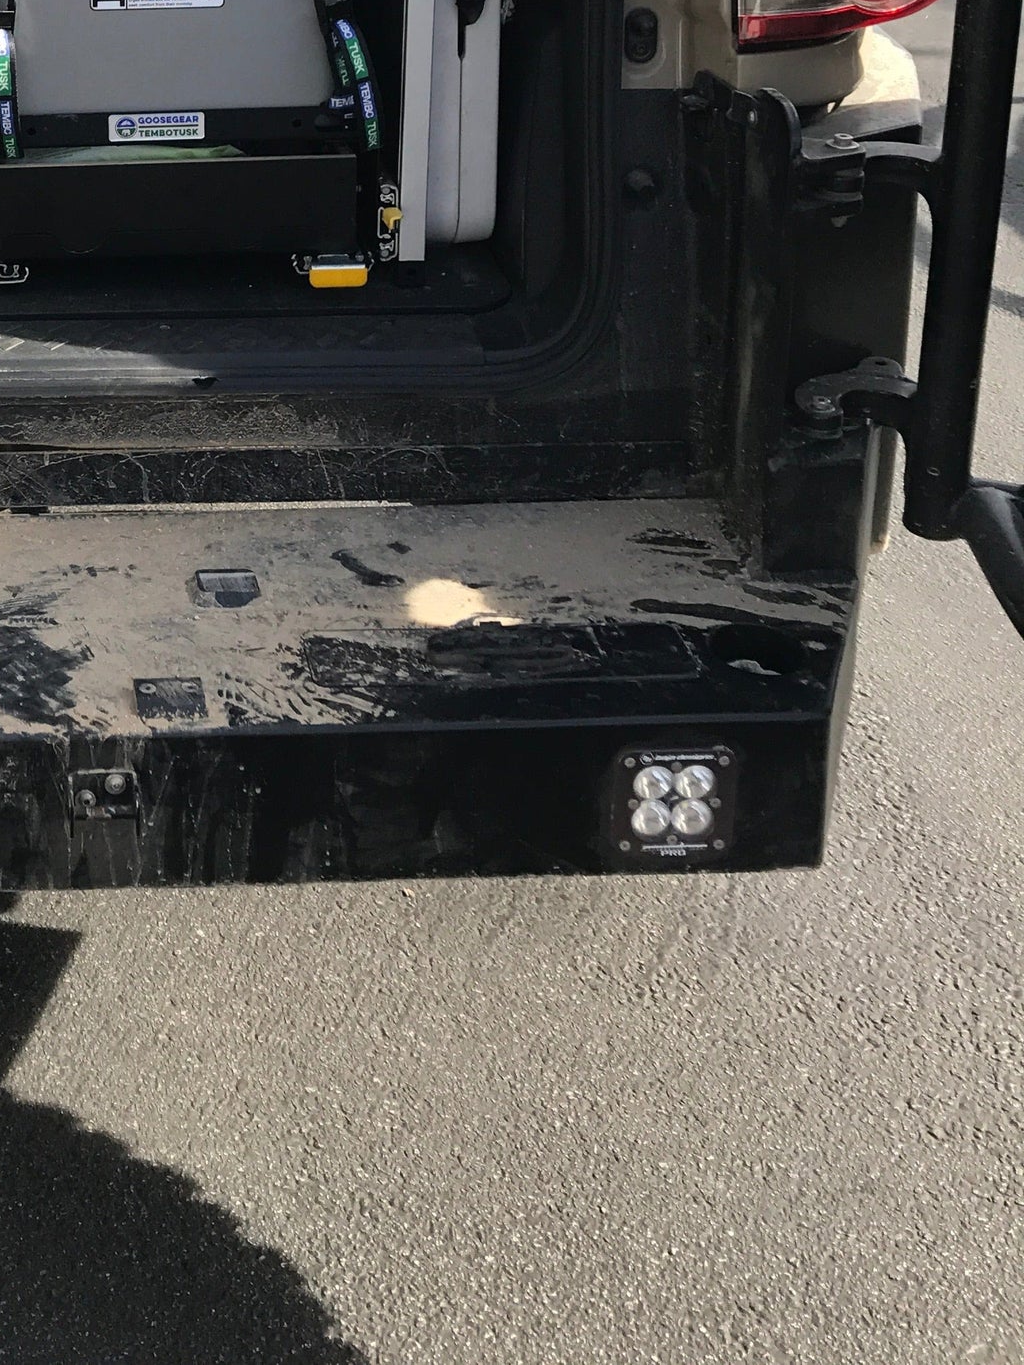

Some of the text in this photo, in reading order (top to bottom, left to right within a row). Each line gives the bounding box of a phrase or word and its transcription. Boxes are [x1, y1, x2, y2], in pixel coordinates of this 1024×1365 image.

[348, 41, 366, 75] TUSK
[359, 82, 375, 119] TEMBO
[367, 121, 379, 148] TUSK
[0, 100, 13, 135] TEMBO
[137, 115, 199, 125] GOOSEGEAR
[138, 128, 199, 137] TEMBOTUSK
[5, 138, 17, 158] TUSK
